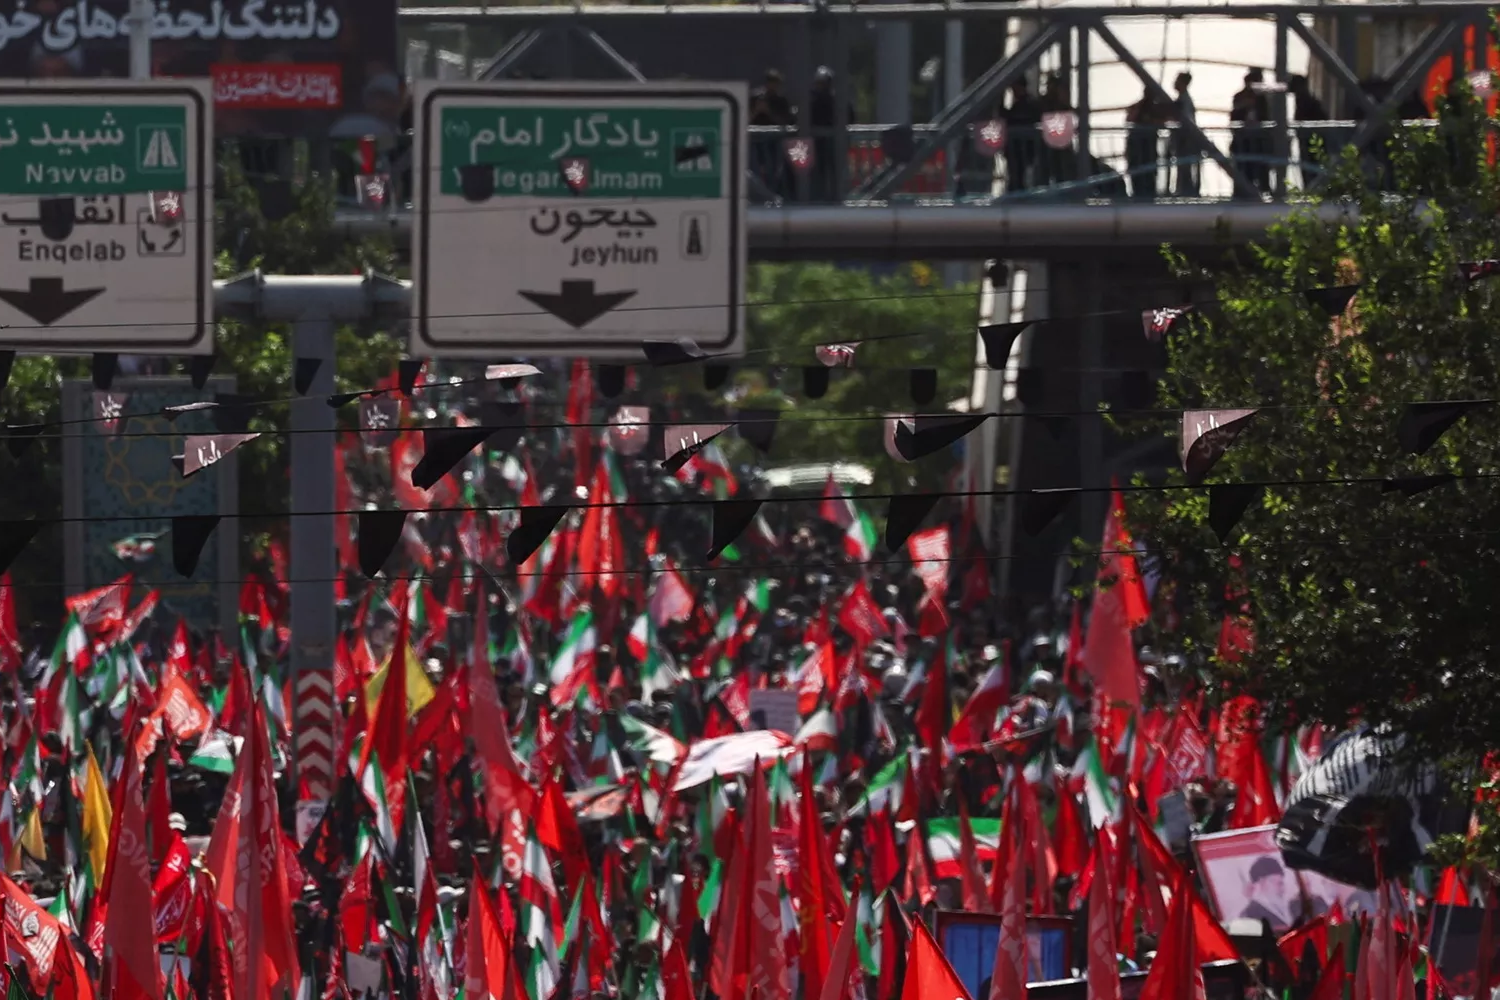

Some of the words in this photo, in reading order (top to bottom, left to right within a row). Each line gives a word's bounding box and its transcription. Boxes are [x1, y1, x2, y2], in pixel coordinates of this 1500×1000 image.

[29, 111, 125, 155] شهید
[469, 116, 543, 164] امام
[549, 113, 659, 159] یادگار
[530, 206, 657, 245] جیحون
[17, 241, 126, 264] Enqelab
